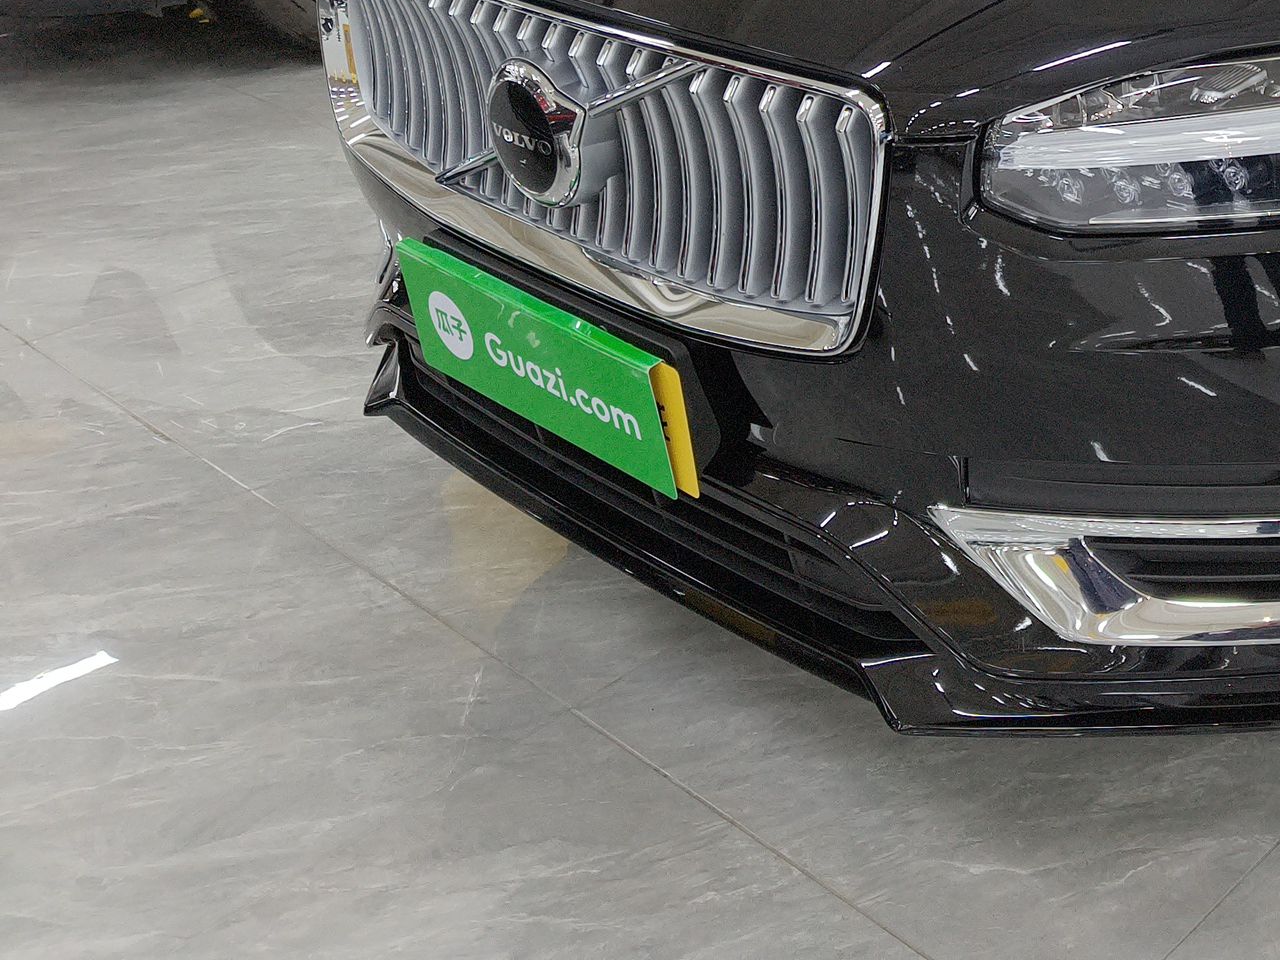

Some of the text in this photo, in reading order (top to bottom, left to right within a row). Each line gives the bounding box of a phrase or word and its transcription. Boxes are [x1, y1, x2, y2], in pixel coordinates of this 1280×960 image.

[491, 121, 553, 157] VOLVO
[435, 307, 468, 342] 瓜子
[484, 332, 642, 441] Guazi.com
